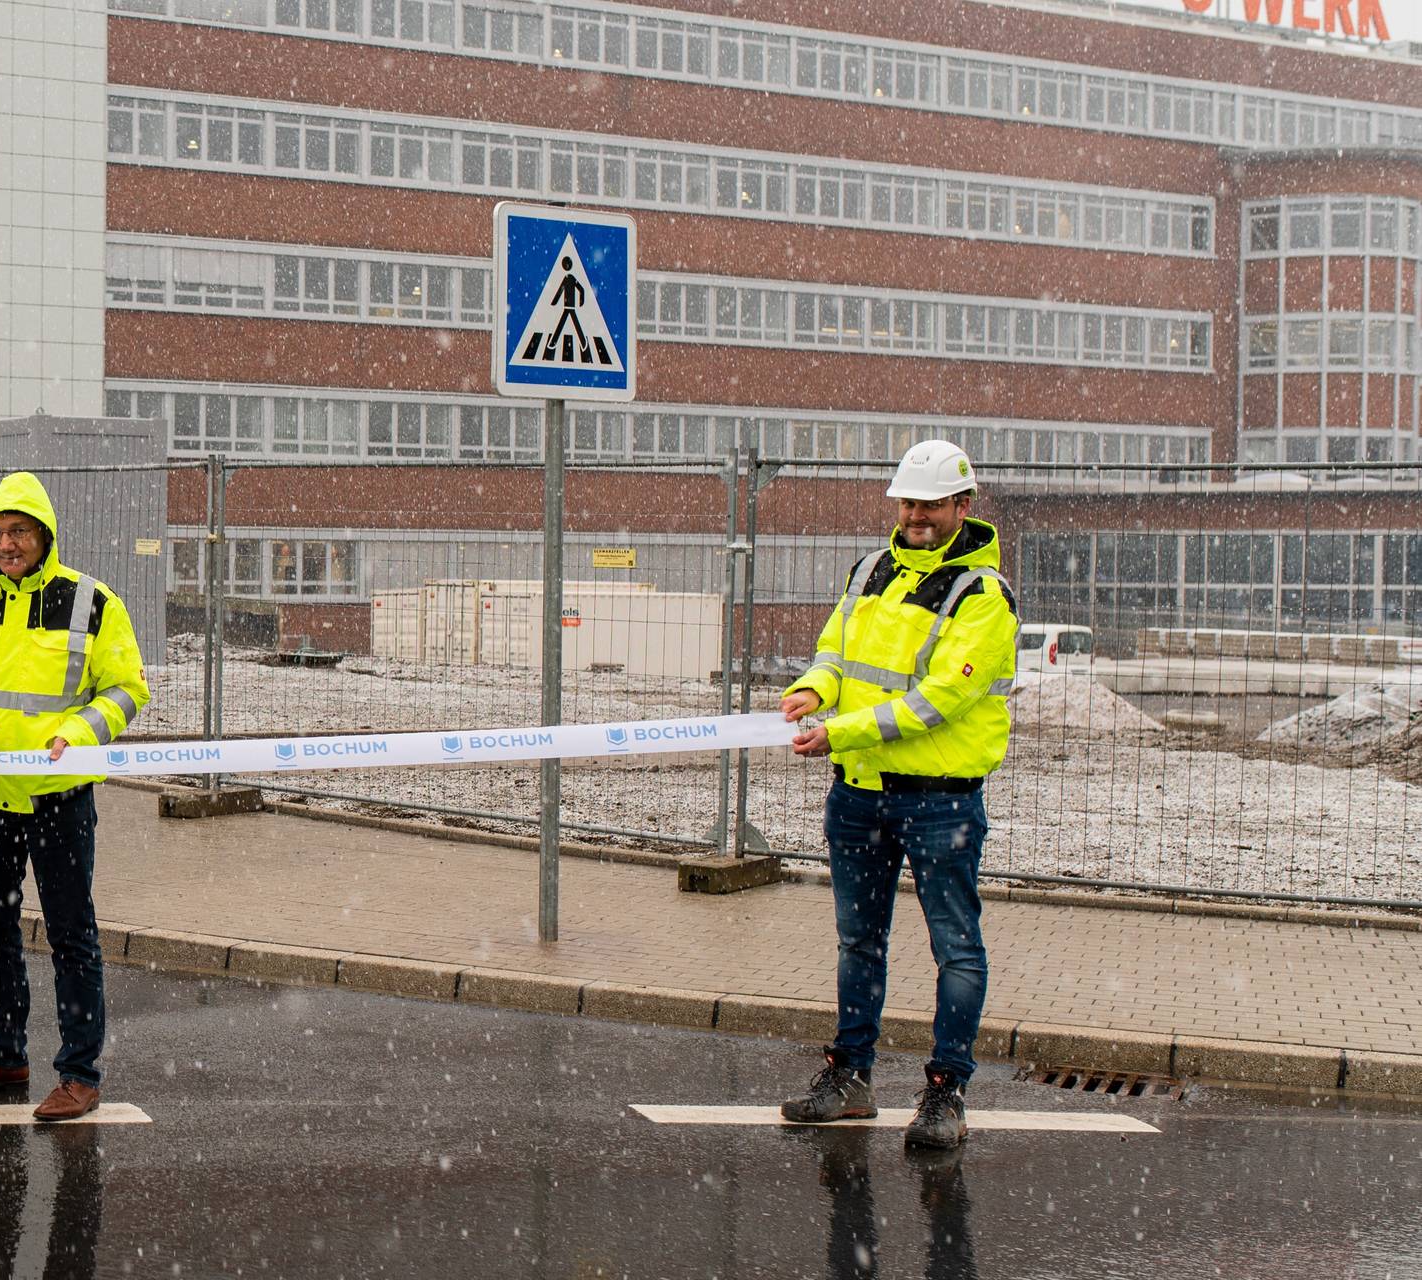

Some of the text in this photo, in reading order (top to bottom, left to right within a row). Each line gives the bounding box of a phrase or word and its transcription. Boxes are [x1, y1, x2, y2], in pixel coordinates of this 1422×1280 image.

[634, 724, 718, 741] BOCHUM
[469, 733, 553, 748] BOCHUM
[136, 749, 221, 763] BOCHUM
[303, 741, 388, 756] BOCHUM
